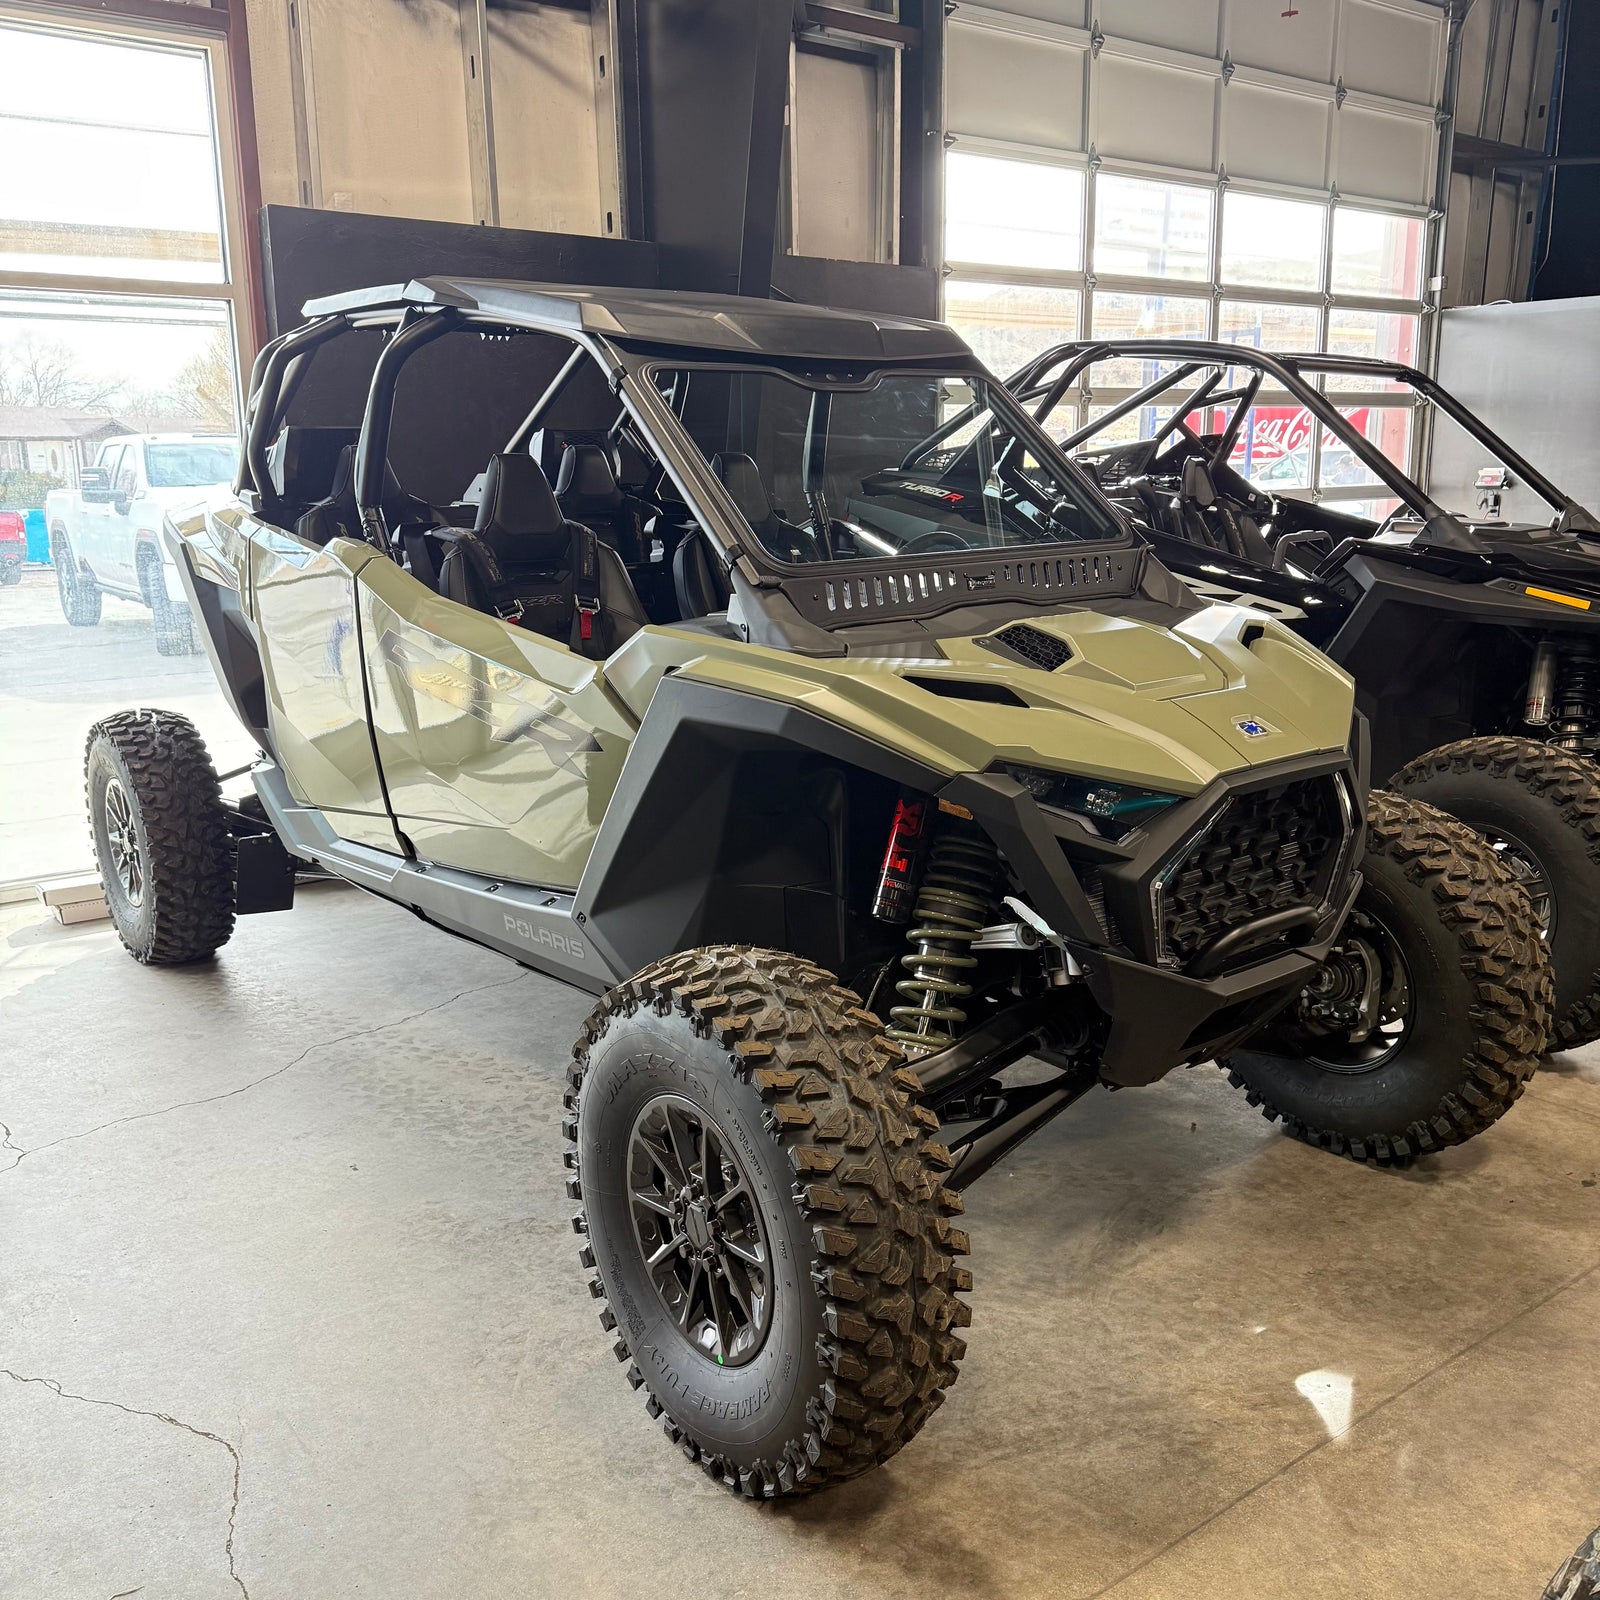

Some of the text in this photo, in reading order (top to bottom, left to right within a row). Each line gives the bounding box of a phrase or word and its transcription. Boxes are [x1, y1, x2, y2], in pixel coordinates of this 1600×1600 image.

[882, 799, 922, 873] FOX
[503, 913, 586, 960] POLARIS
[606, 1052, 709, 1105] MAXXIS
[643, 1344, 772, 1420] RAMPAGE FURY
